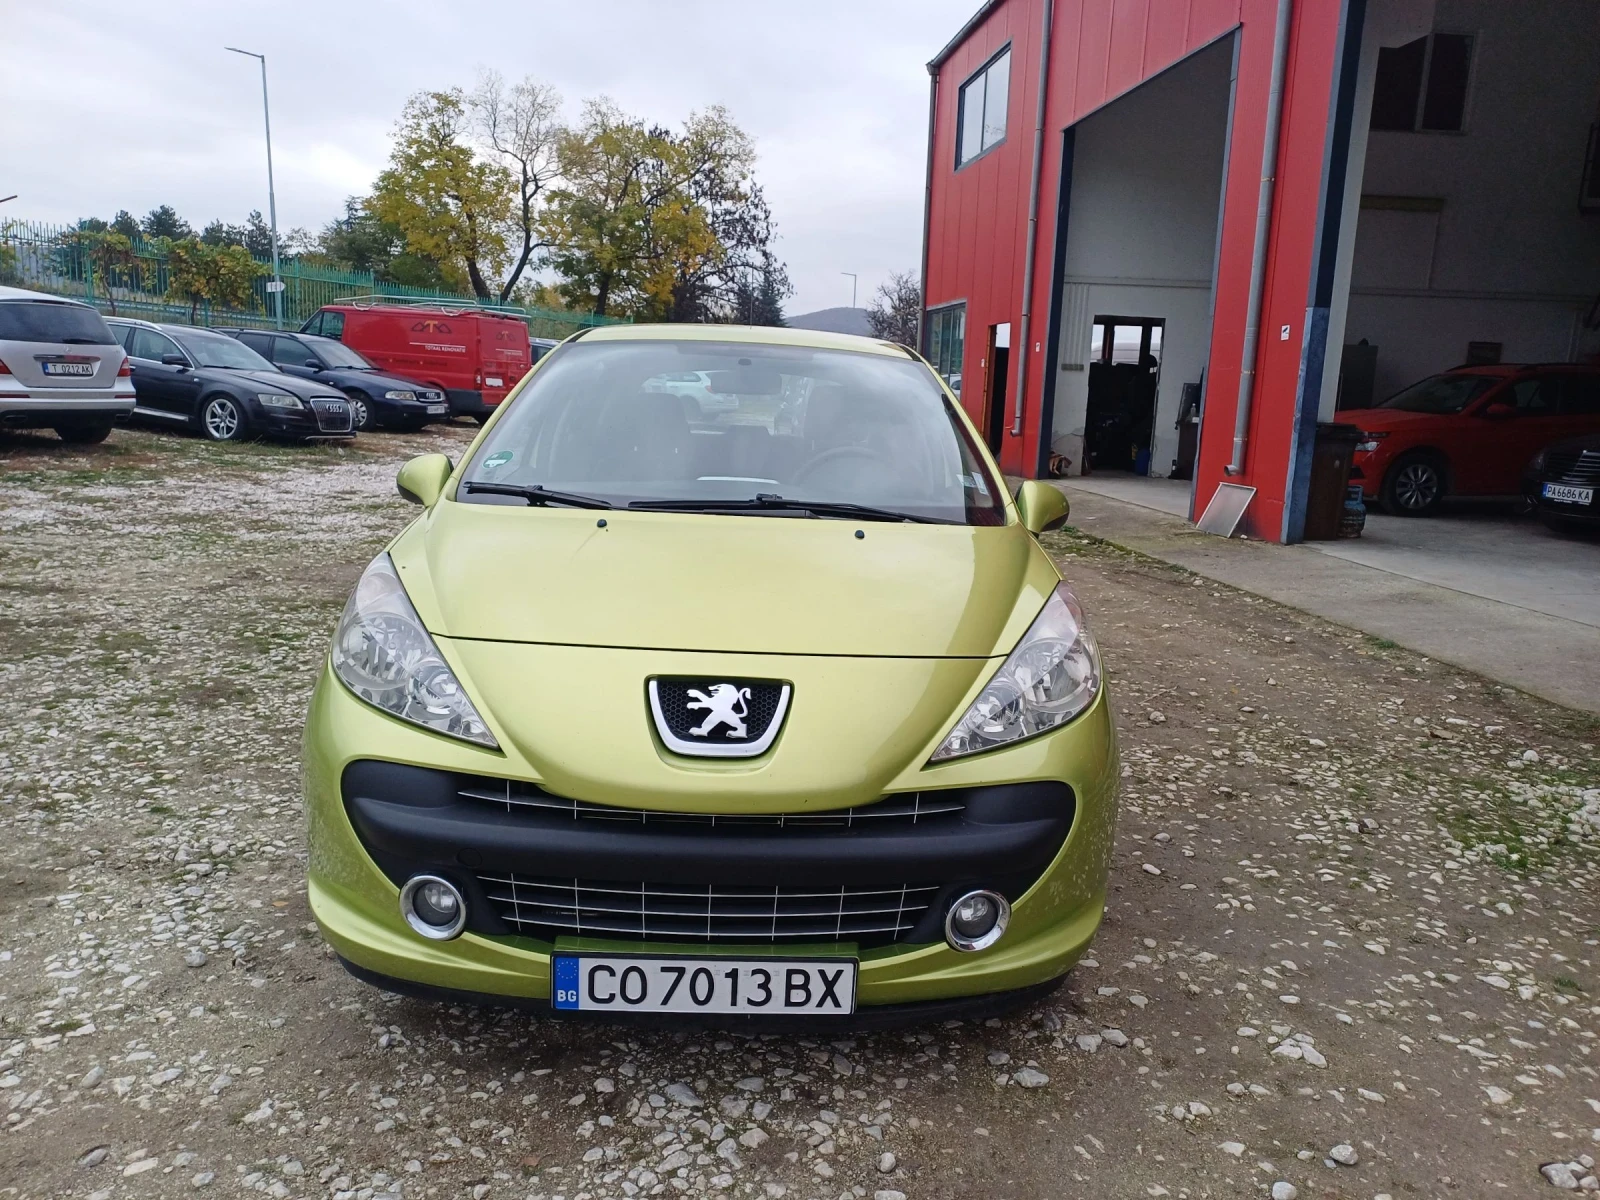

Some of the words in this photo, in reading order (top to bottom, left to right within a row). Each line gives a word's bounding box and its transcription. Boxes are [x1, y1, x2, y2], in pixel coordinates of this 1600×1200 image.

[61, 364, 80, 374] 0212
[81, 365, 90, 374] AK
[1547, 486, 1556, 497] PA
[1557, 487, 1577, 500] 6686
[1578, 490, 1590, 501] KA
[660, 966, 773, 1007] 7013
[784, 968, 845, 1009] BX
[557, 990, 577, 1002] BG
